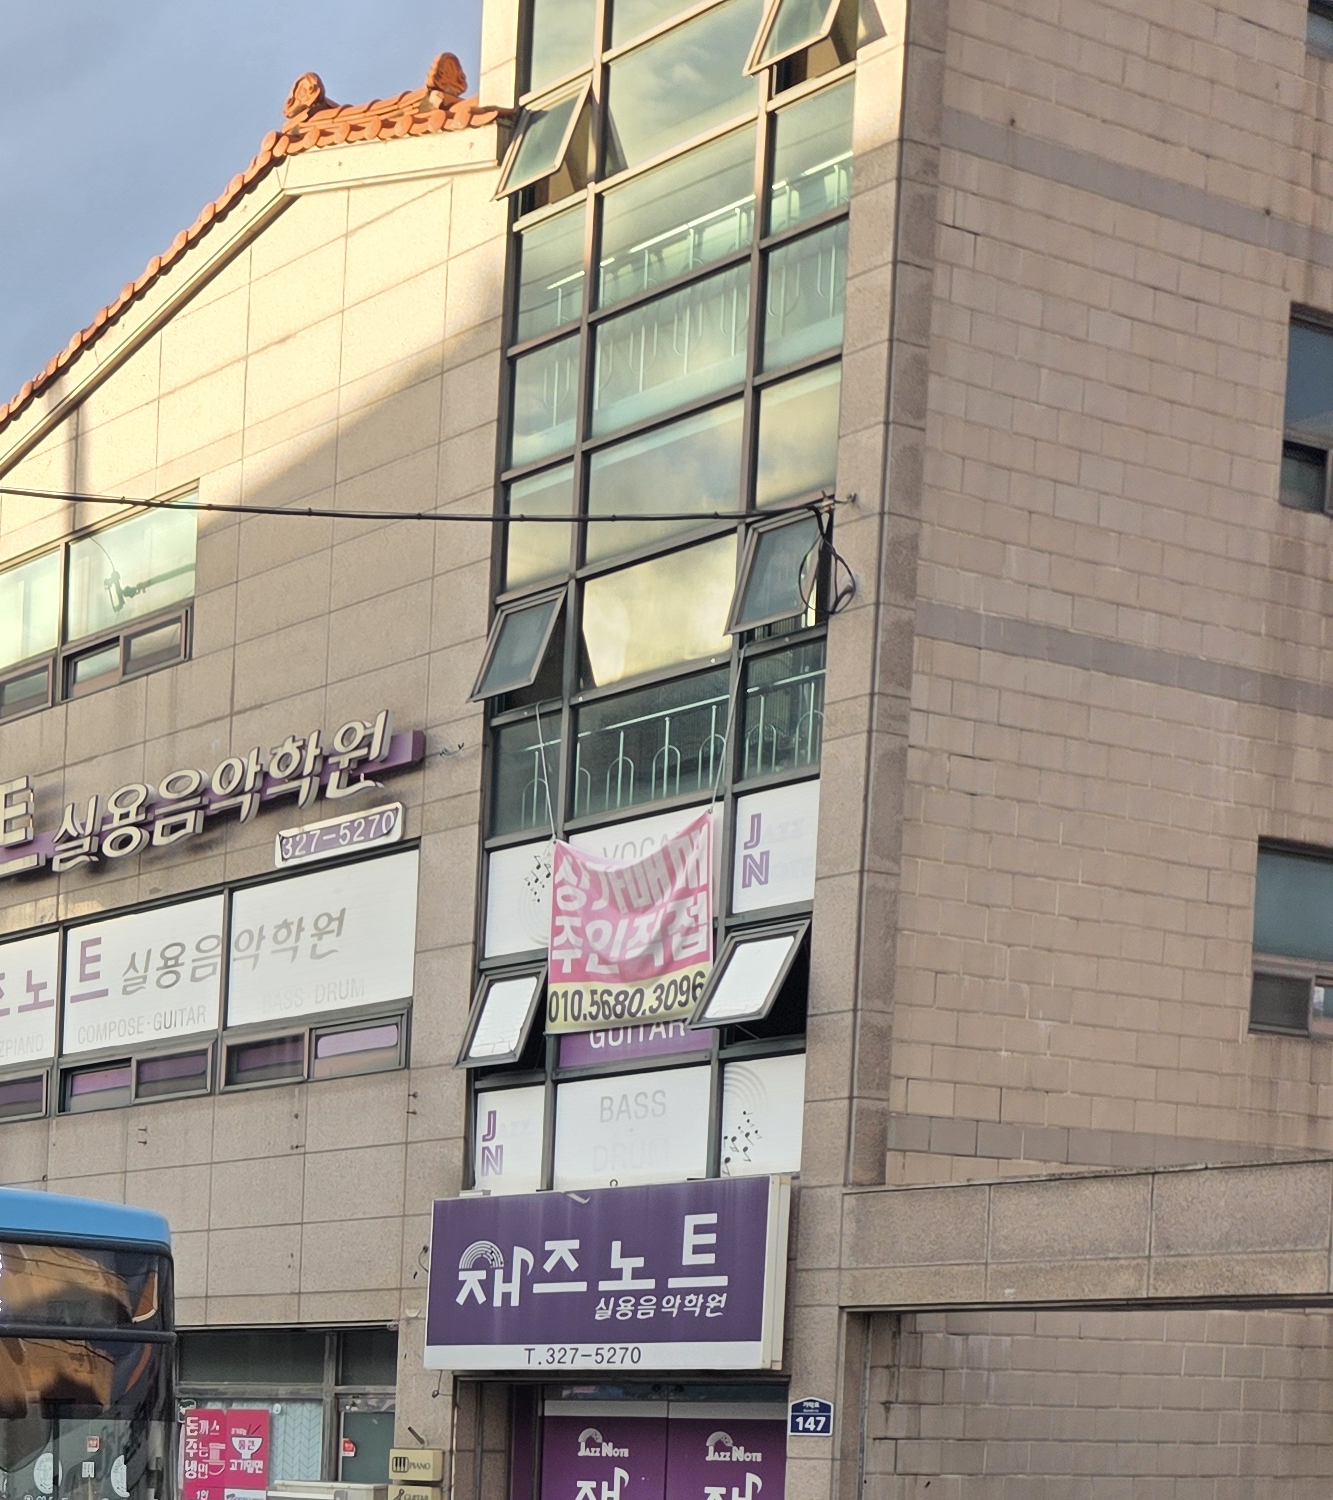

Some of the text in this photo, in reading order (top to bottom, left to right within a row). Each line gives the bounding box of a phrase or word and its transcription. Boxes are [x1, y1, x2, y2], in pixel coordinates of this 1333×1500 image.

[51, 710, 394, 872] 실용음악학원
[281, 810, 394, 862] 327-5270
[121, 906, 347, 996] 실용음악학원
[552, 889, 710, 975] 주인직접
[548, 969, 706, 1024] 010.5680.3096
[455, 1212, 729, 1307] 재즈노트
[593, 1293, 728, 1322] 실용음악학원
[524, 1346, 642, 1368] T.327-5270
[185, 1416, 220, 1437] 돈까스
[795, 1416, 827, 1432] 147
[185, 1438, 209, 1458] 주는
[409, 1461, 431, 1470] PIANO
